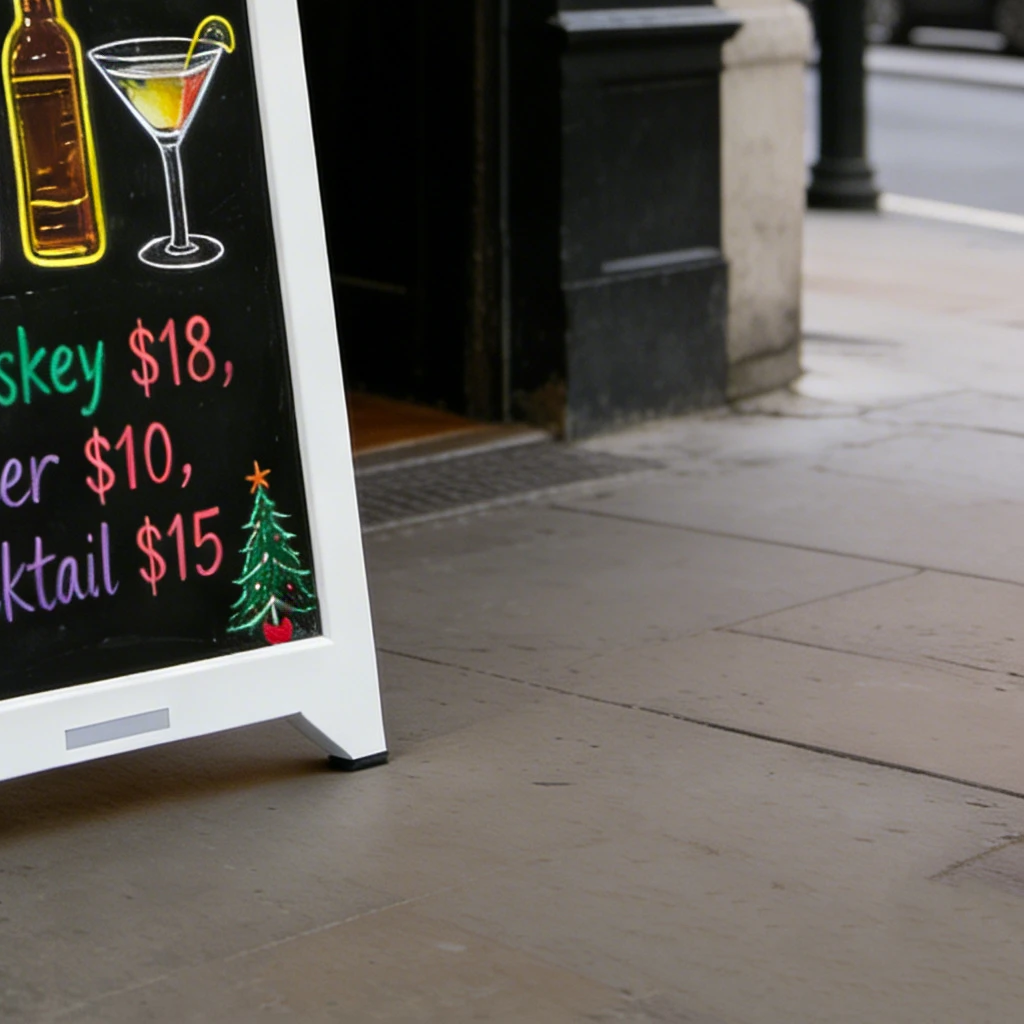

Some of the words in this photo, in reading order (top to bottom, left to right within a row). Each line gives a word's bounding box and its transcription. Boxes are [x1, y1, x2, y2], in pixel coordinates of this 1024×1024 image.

[128, 315, 234, 398] $18,
[83, 421, 193, 506] $10,
[135, 506, 225, 597] $15
